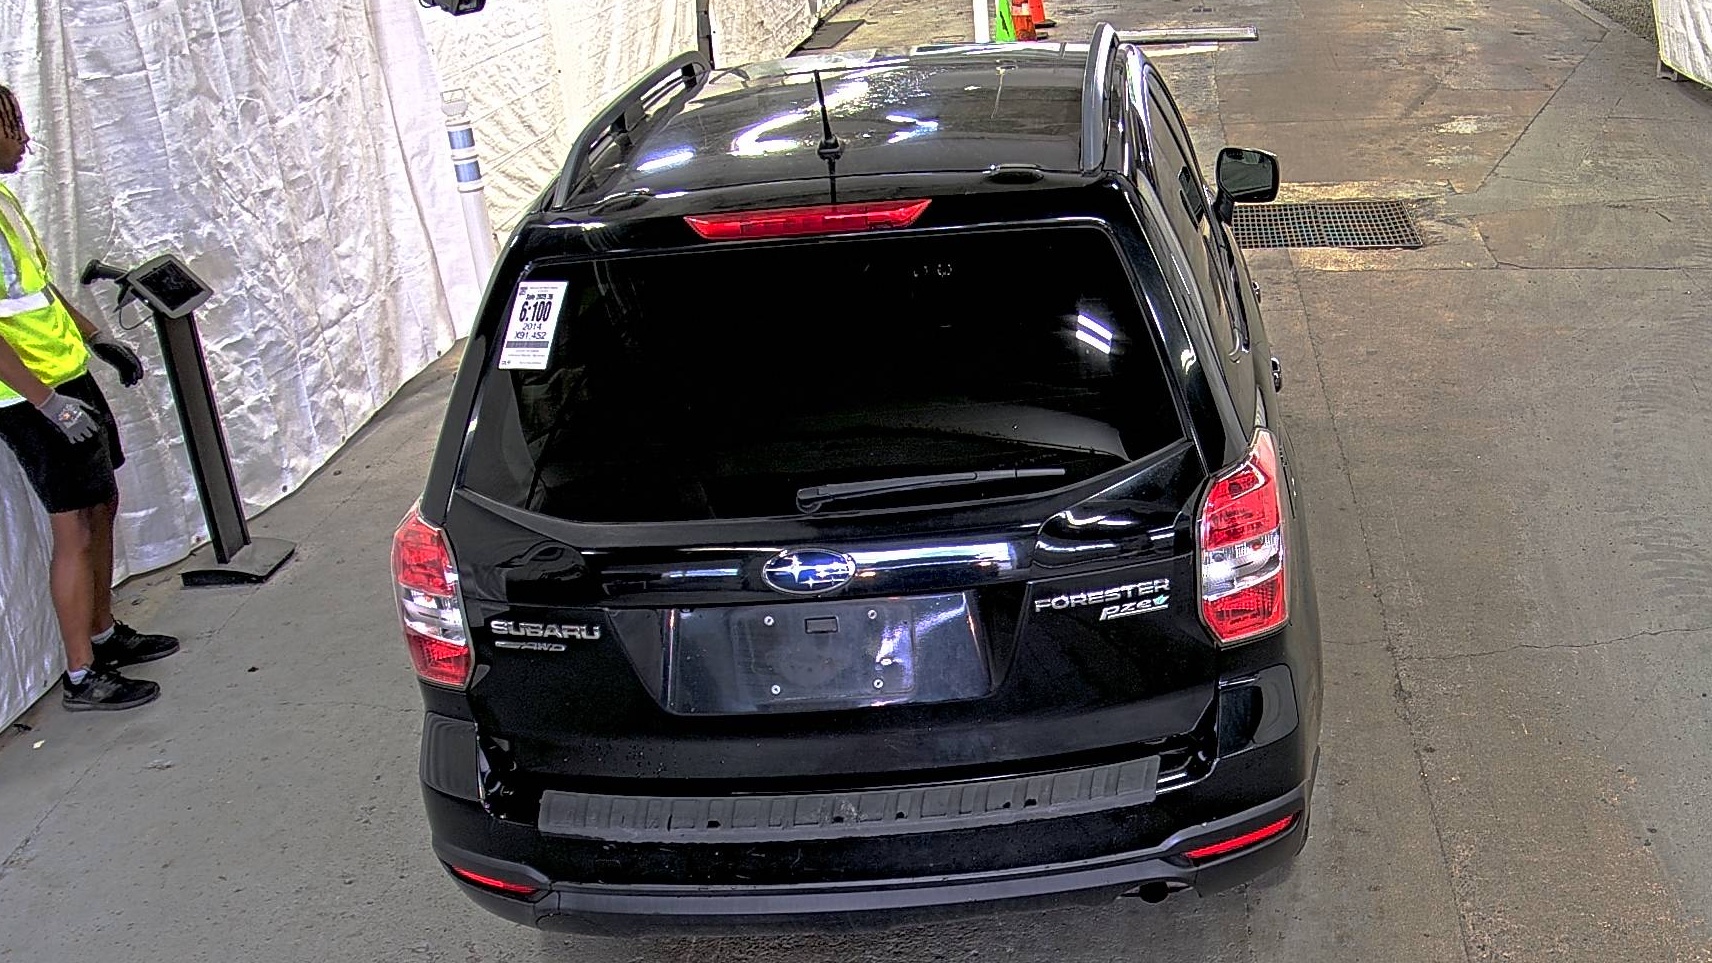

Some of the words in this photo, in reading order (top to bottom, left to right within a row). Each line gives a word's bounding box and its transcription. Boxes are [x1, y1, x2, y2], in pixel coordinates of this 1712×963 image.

[519, 300, 552, 322] 6:100
[522, 322, 542, 331] 2014
[1034, 578, 1171, 613] FORESTER
[490, 620, 600, 640] SUBARU
